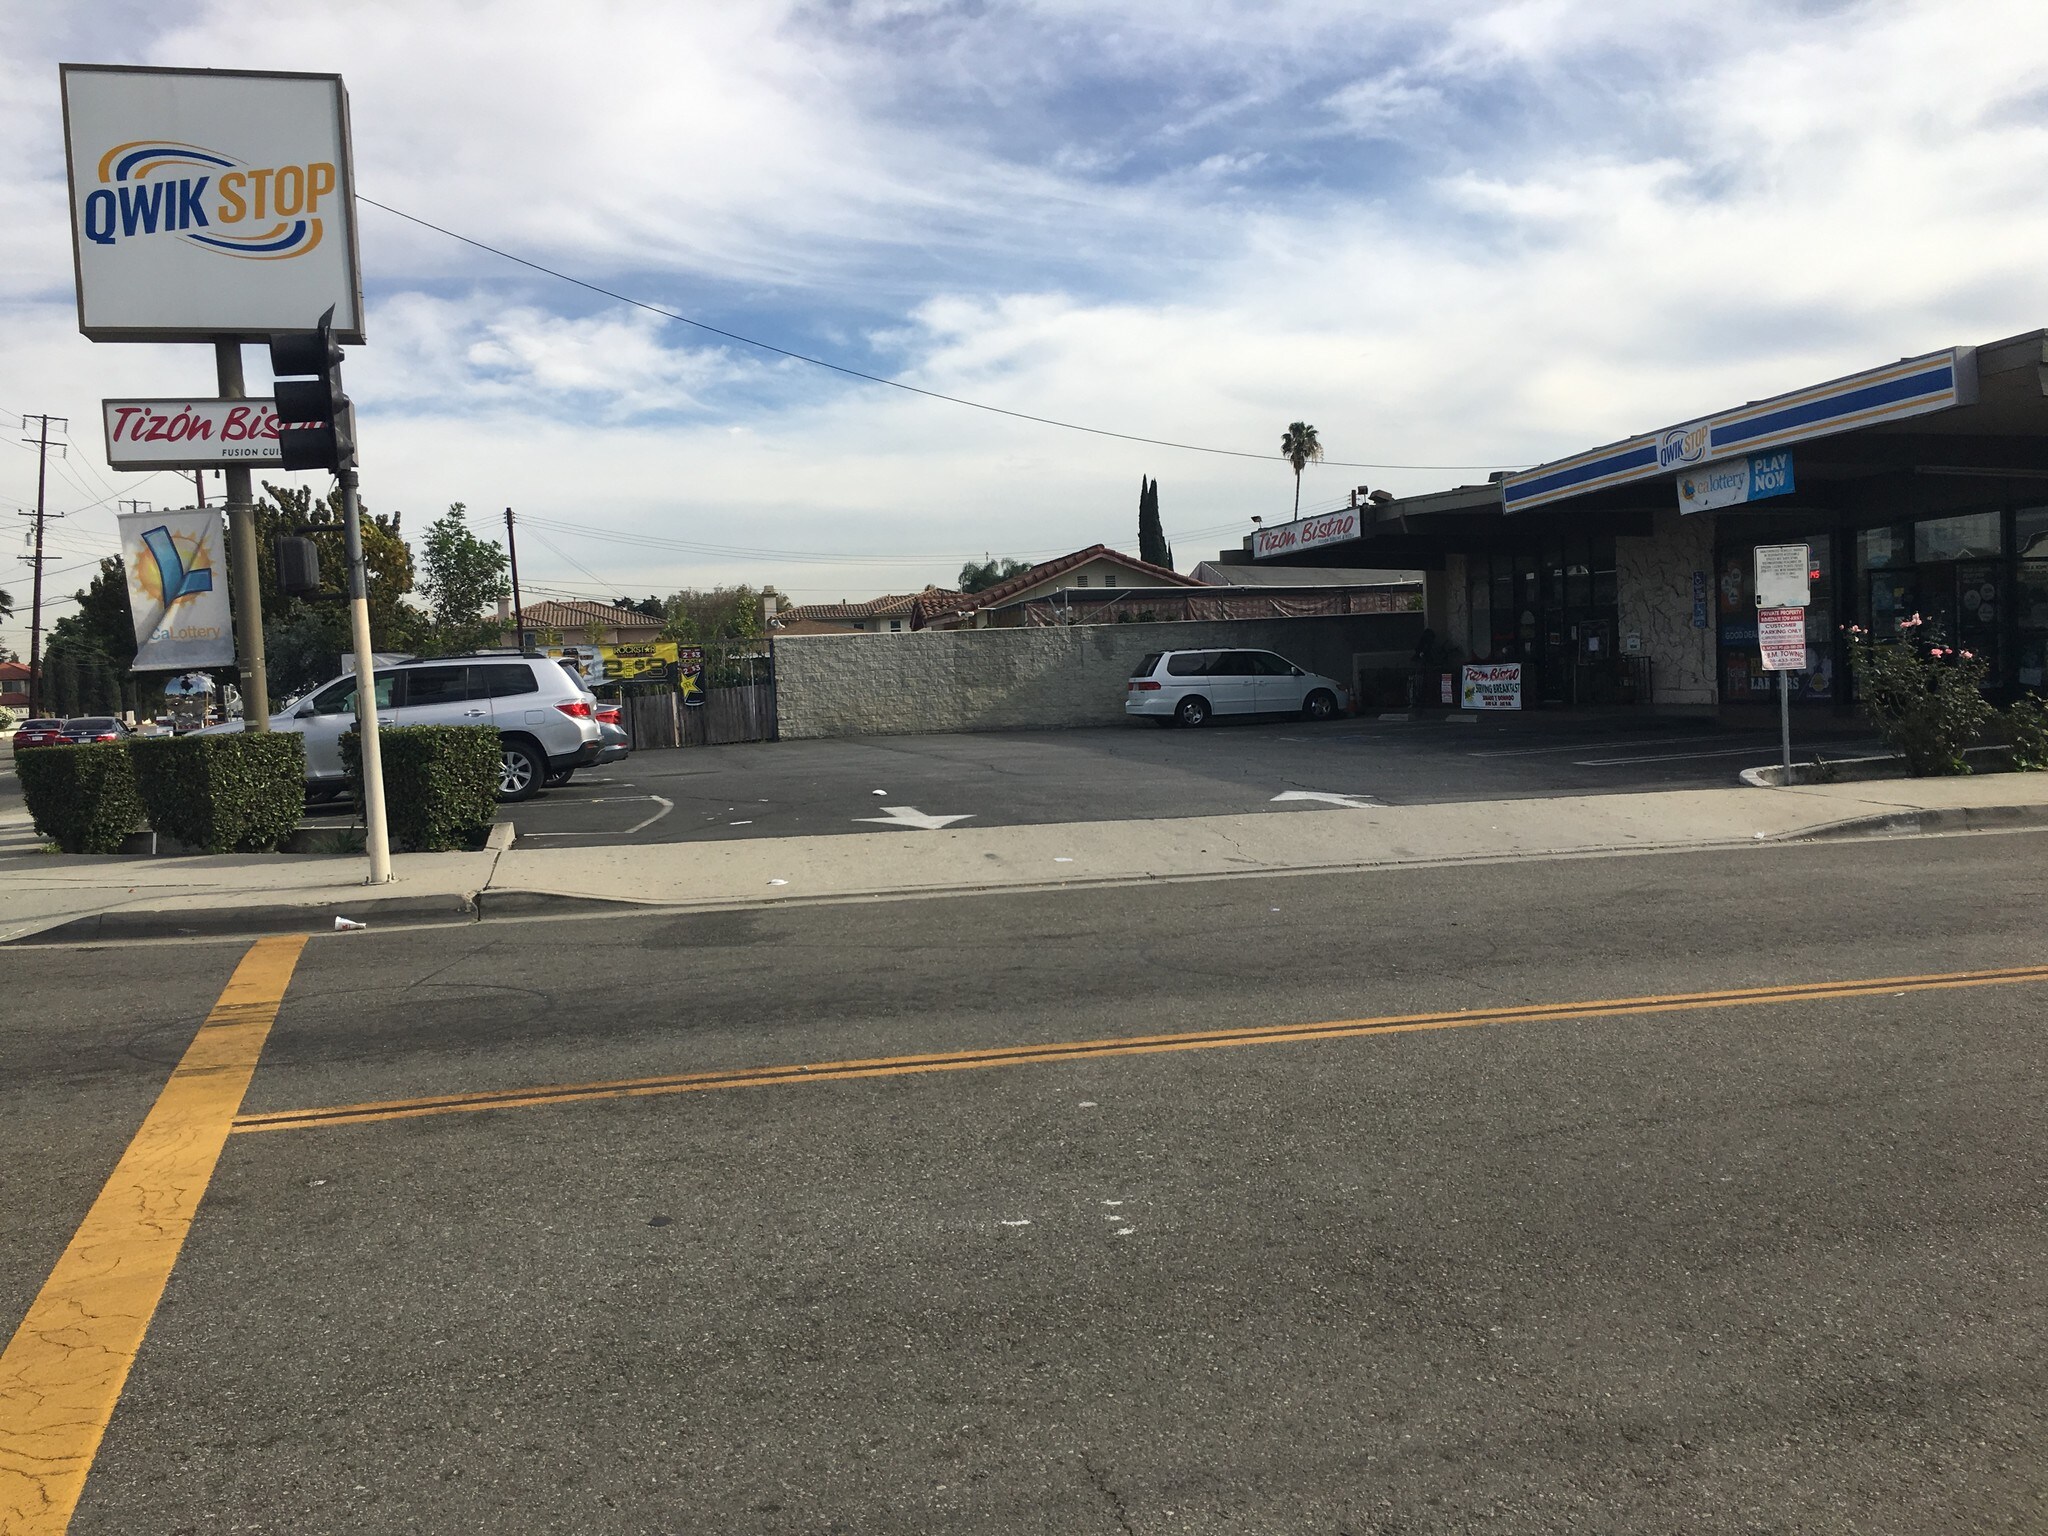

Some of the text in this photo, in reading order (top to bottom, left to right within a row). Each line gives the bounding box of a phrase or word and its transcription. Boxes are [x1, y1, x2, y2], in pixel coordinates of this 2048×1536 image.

[85, 162, 336, 244] QWIK STOP
[113, 404, 216, 443] Tizón
[222, 448, 259, 457] FUSION
[1660, 425, 1708, 467] QWIK STOP
[1754, 453, 1788, 475] PLAY
[1697, 472, 1746, 495] calottery
[1755, 470, 1786, 492] NOW
[1258, 527, 1297, 553] Tizón
[1301, 515, 1354, 544] Bistro
[150, 624, 221, 641] CaLottery
[1780, 650, 1804, 658] TOWING
[602, 658, 623, 679] 2
[1493, 682, 1520, 694] BREAKFAST
